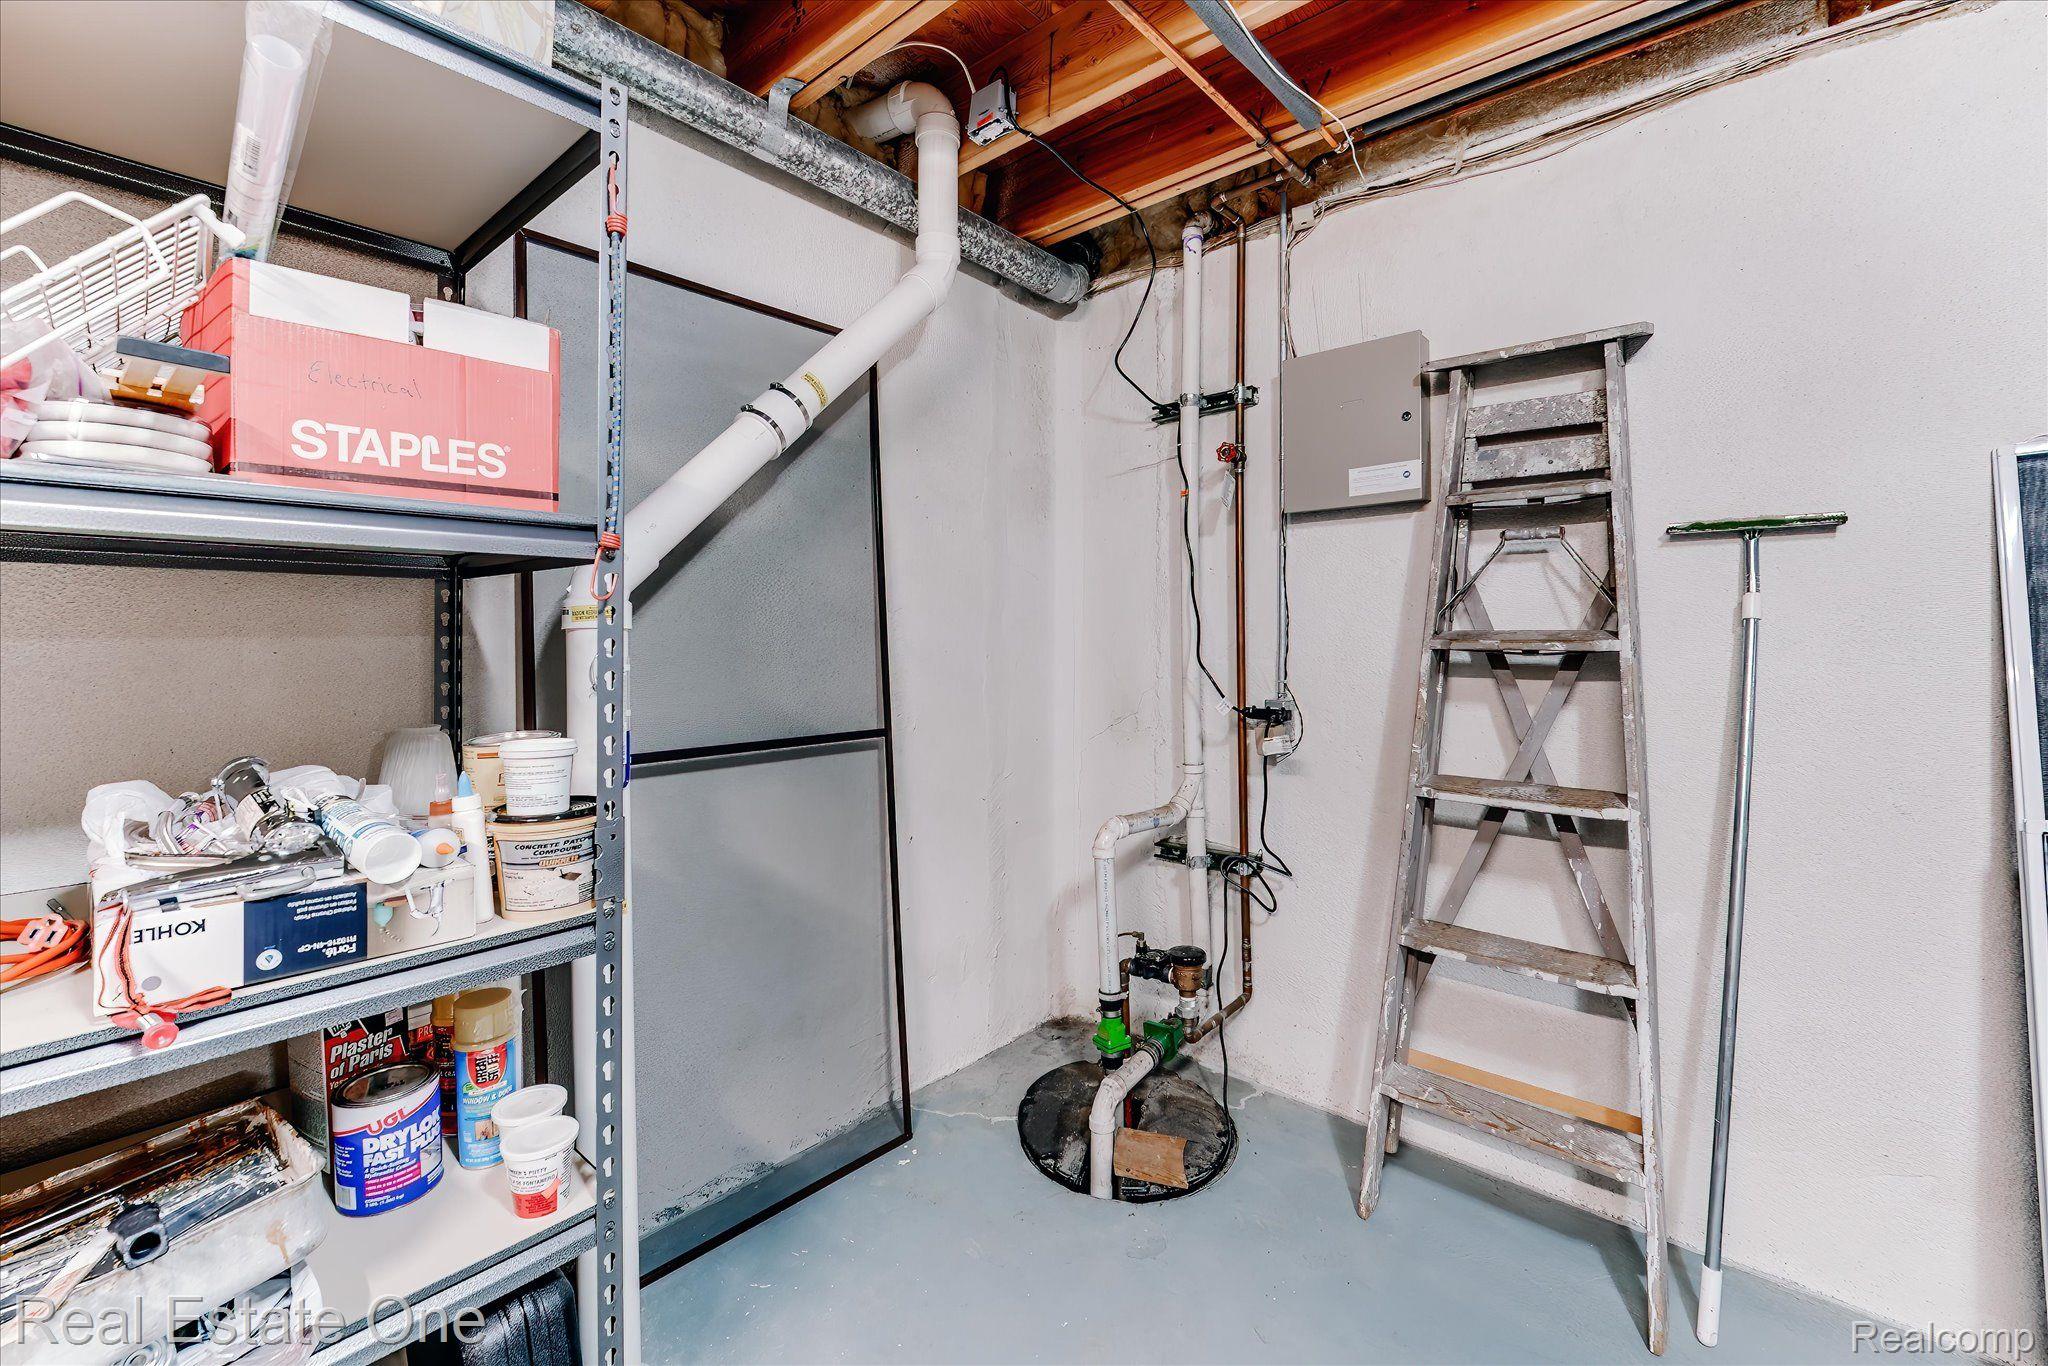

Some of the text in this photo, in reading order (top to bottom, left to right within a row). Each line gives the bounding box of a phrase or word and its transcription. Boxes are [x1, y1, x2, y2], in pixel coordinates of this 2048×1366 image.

[306, 360, 423, 400] Electrical
[290, 418, 507, 479] STAPLES
[514, 841, 560, 851] CONCRETE
[533, 844, 582, 856] COMPOUND
[131, 917, 206, 945] KOHLE
[330, 1027, 393, 1064] Plaster
[330, 1043, 394, 1079] of Paris
[362, 1104, 441, 1155] DRYLOK
[367, 1107, 406, 1135] UGL
[362, 1144, 407, 1168] FAST
